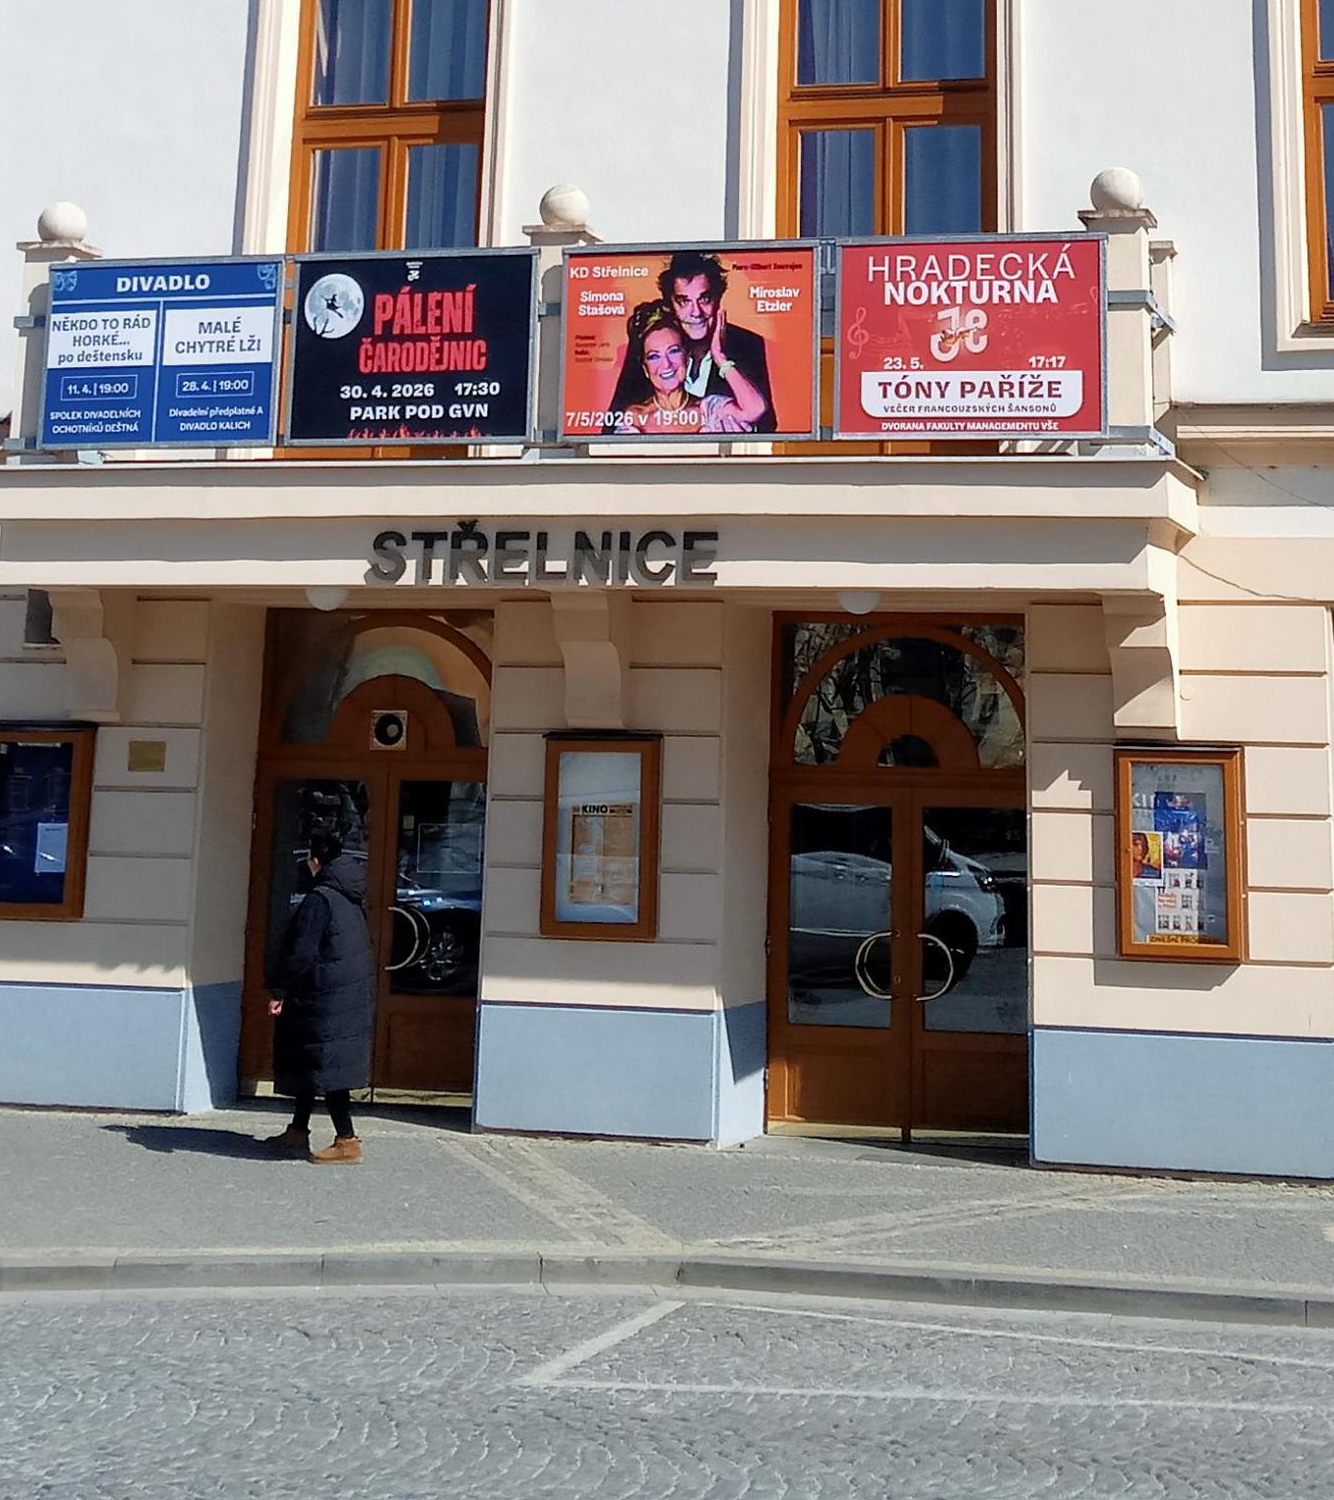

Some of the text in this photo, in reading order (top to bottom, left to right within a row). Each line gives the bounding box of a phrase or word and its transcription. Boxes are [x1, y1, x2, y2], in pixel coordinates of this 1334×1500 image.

[867, 243, 1076, 282] HRADECKÁ
[570, 265, 649, 279] KD Střelnice
[116, 274, 211, 293] DIVADLO
[580, 290, 624, 302] Simona
[749, 285, 801, 299] Miroslav
[884, 280, 1059, 306] NOKTURNA
[373, 283, 478, 336] PÁLENÍ
[578, 303, 625, 316] Stašová
[756, 300, 793, 313] Etzler
[52, 314, 151, 332] NĚKDO TO RÁD
[198, 316, 242, 335] MALÉ
[72, 330, 130, 347] HORKÉ...
[175, 335, 261, 354] CHYTRÉ LŽI
[58, 349, 143, 366] po deštensku
[358, 335, 488, 374] ČARODĚJNIC
[883, 355, 1067, 370] 23. 5. 17:17
[99, 382, 129, 394] 19:00
[182, 379, 249, 392] 28. 4. 19:00
[340, 382, 501, 399] 30. 4. 2026 17:30
[877, 374, 1063, 400] TÓNY PAŘÍŽE
[50, 407, 141, 420] SPOLEK DIVADELNÍCH
[169, 406, 264, 418] Divadelní předplatné A
[349, 403, 489, 421] PARK POD GVN
[883, 401, 1057, 413] VEČER FRANCOUZSKÝCH ŠANSONŮ
[52, 420, 139, 433] OCHOTNÍKŮ DEŠTNÁ
[179, 420, 251, 431] DIVADLO KALICH
[566, 410, 699, 428] 7/5/2026 v 19:00
[881, 419, 1059, 431] DVORANA FAKULTY MANAGEMENTU VŠE
[369, 519, 718, 581] STŘELNICE
[581, 804, 609, 814] KINO
